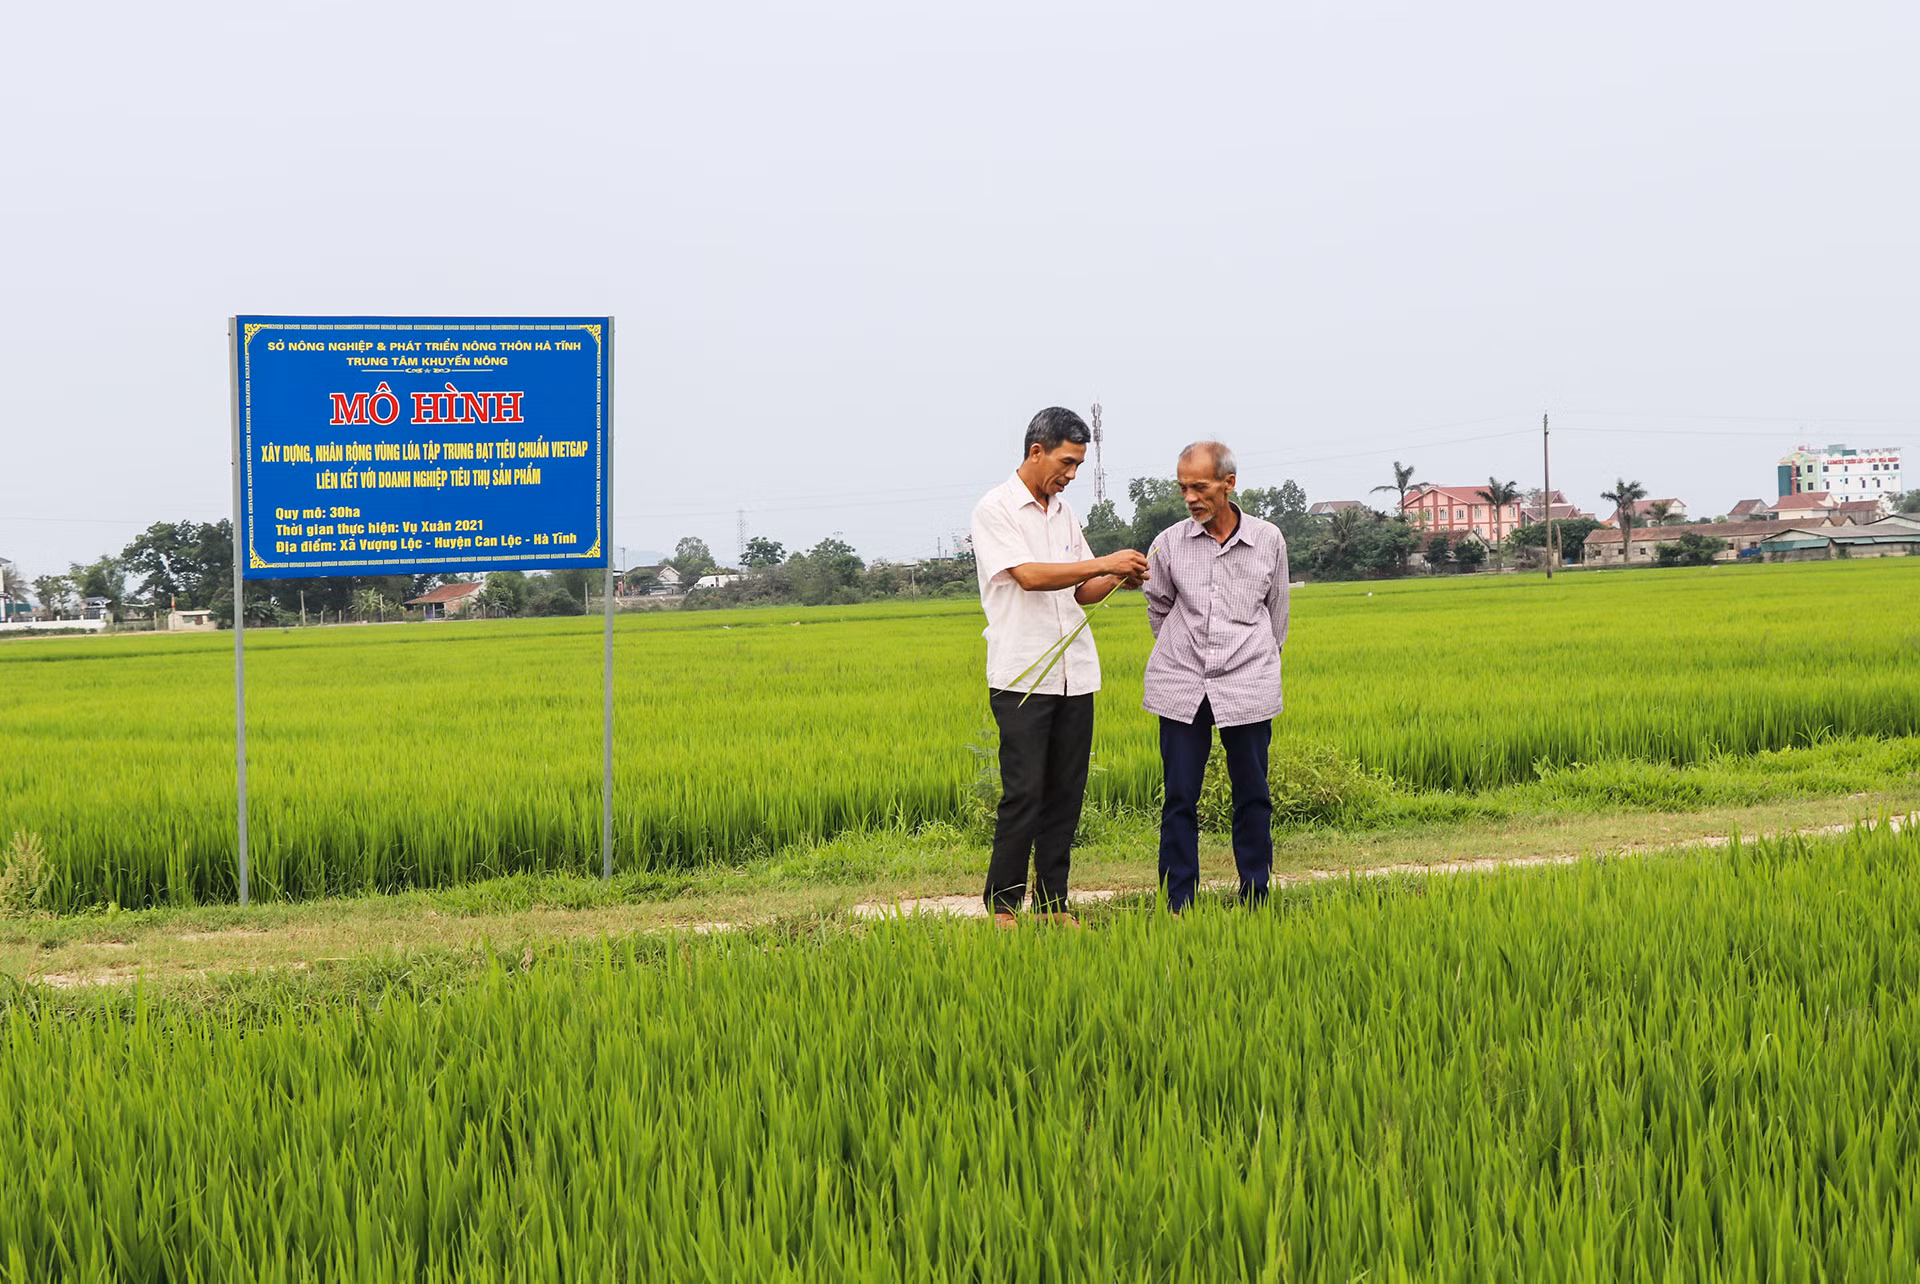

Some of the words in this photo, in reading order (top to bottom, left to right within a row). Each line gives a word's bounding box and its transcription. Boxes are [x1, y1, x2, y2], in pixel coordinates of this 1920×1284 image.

[268, 339, 285, 351] SỞ
[288, 340, 325, 351] NÔNG
[328, 340, 373, 353] NGHIỆP
[377, 342, 386, 351] &
[390, 340, 421, 351] PHÁT
[425, 338, 459, 351] TRIỂN
[462, 340, 496, 351] NÔNG
[500, 340, 532, 351] THÔN
[535, 340, 551, 350] HÀ
[555, 340, 581, 350] TĨNH
[346, 357, 388, 366] TRUNG
[392, 356, 418, 366] TÂM
[422, 354, 470, 366] KHUYẾN
[474, 355, 508, 366] NÔNG
[330, 381, 400, 426] MÔ
[410, 382, 524, 425] HÌNH
[261, 442, 280, 462] XÂY
[283, 444, 314, 466] DỰNG,
[316, 441, 343, 462] NHÂN
[346, 441, 372, 465] RỘNG
[374, 440, 400, 461] VÙNG
[402, 440, 420, 461] LÚA
[423, 440, 441, 464] TẬP
[443, 443, 474, 460] TRUNG
[476, 443, 494, 463] ĐẠT
[496, 438, 516, 458] TIÊU
[518, 435, 549, 458] CHUẨN
[551, 441, 588, 457] VIETGAP
[316, 469, 338, 489] LIÊN
[340, 466, 358, 489] KẾT
[360, 467, 376, 488] VỚI
[378, 471, 411, 488] DOANH
[413, 467, 448, 491] NGHIỆP
[450, 466, 470, 486] TIÊU
[473, 470, 490, 490] THỤ
[492, 462, 512, 486] SẢN
[514, 462, 541, 485] PHẨM
[275, 507, 299, 520] Quy
[302, 507, 326, 519] mô:
[329, 506, 360, 518] 30ha
[275, 523, 303, 536] Thời
[306, 524, 334, 537] gian
[337, 523, 365, 536] thực
[368, 522, 399, 535] hiện:
[402, 521, 418, 535] Vụ
[421, 520, 452, 532] Xuân
[455, 519, 483, 531] 2021
[275, 541, 297, 555] Địa
[301, 538, 336, 552] điểm:
[340, 538, 356, 551] Xã
[359, 539, 397, 552] Vượng
[401, 538, 422, 551] Lộc
[434, 536, 471, 550] Huyện
[475, 535, 498, 547] Can
[501, 534, 522, 548] Lộc
[533, 533, 549, 545] Hà
[552, 532, 577, 544] Tĩnh
